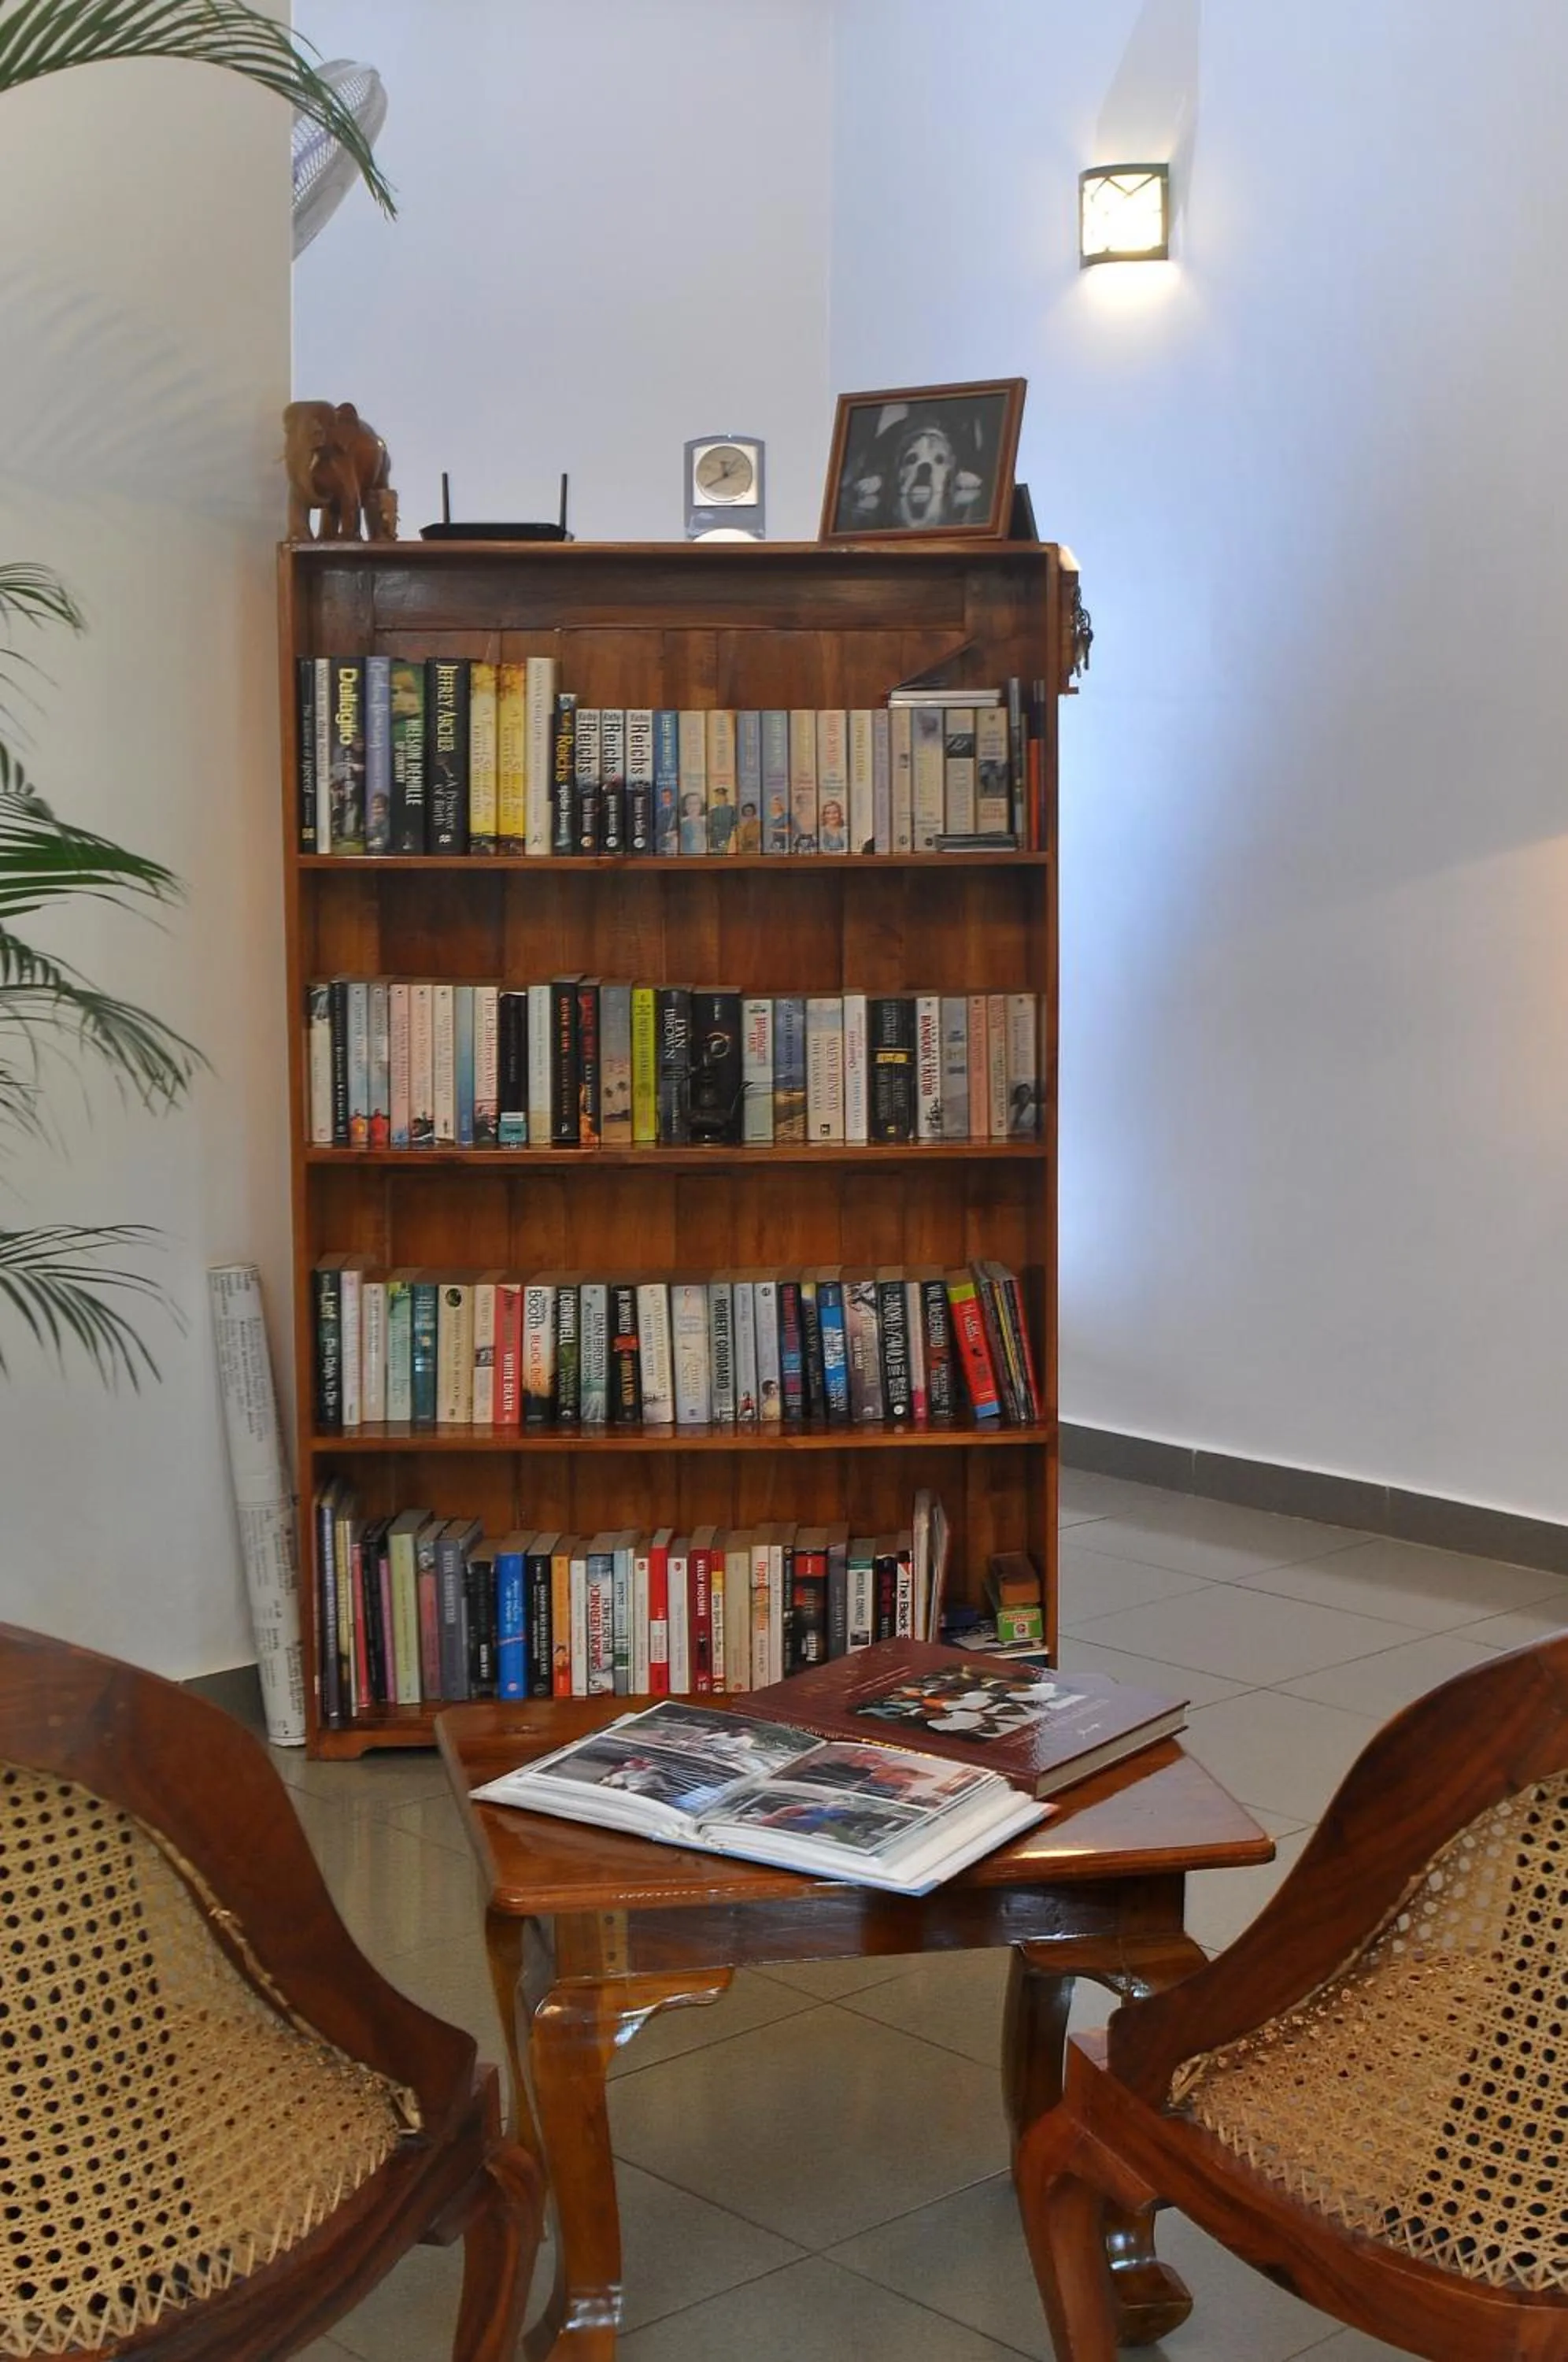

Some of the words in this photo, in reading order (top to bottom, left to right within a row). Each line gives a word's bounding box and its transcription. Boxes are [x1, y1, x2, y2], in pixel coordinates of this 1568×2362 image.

[435, 664, 459, 707] JEFFREY
[335, 668, 358, 746] Dallaglio
[406, 719, 423, 759] NELSON
[556, 734, 573, 782] Reichs
[577, 724, 598, 773] Reichs
[602, 724, 623, 773] Reichs
[630, 724, 650, 775] Reichs
[405, 762, 423, 805] DEMILLE
[664, 1009, 676, 1059] BROWN
[675, 1018, 687, 1050] DAN
[527, 1290, 545, 1330] Booth
[558, 1294, 579, 1346] CORNWELL
[593, 1312, 604, 1335] DAN
[714, 1298, 730, 1338] ROBERT
[503, 1352, 515, 1380] WHITE
[593, 1338, 605, 1380] BROWN
[716, 1338, 731, 1390] GODDARD
[503, 1383, 514, 1411] DEATH
[856, 1572, 865, 1597] MICHAEL
[899, 1579, 909, 1598] The
[589, 1583, 601, 1629] KERNICK
[856, 1598, 866, 1626] CONNELLY
[899, 1601, 910, 1630] Black
[589, 1631, 601, 1671] SIMON
